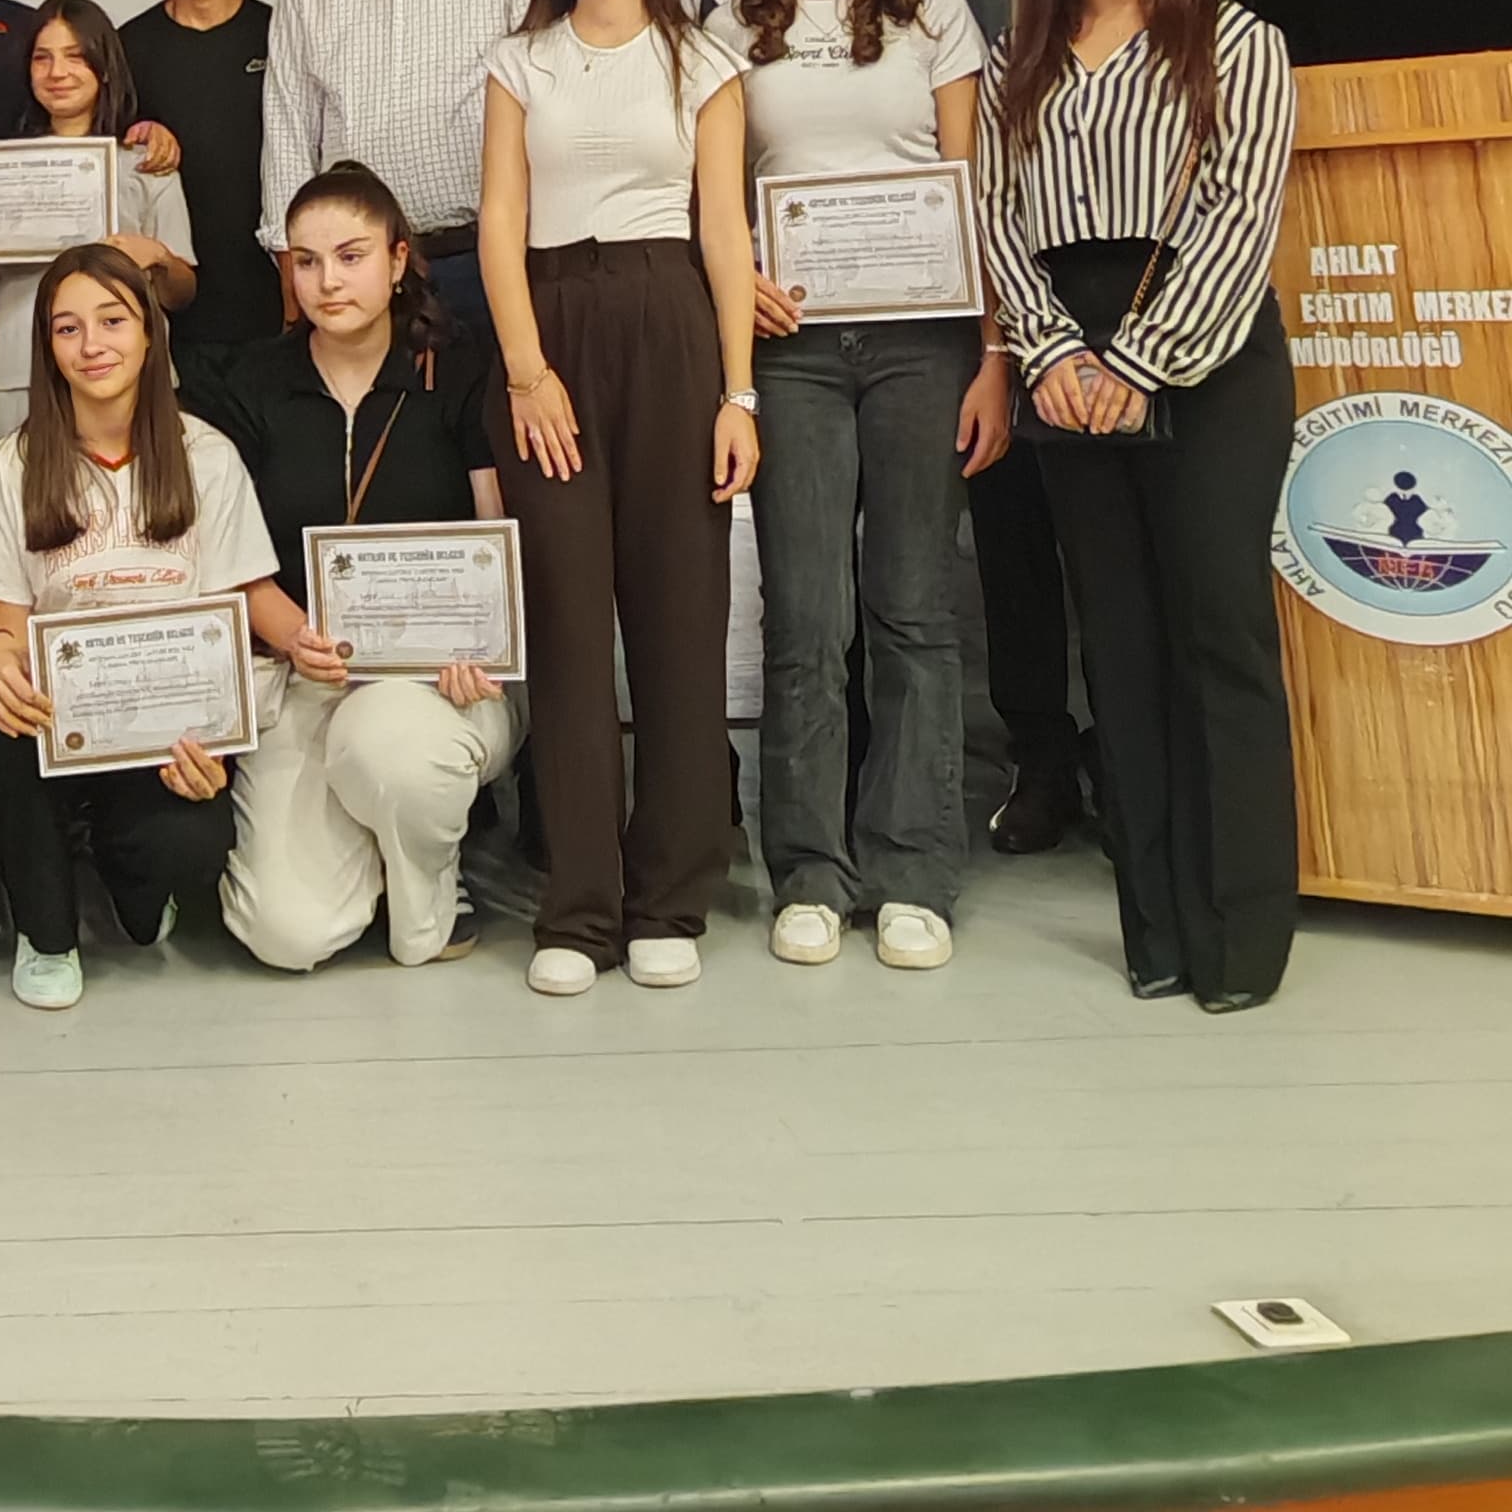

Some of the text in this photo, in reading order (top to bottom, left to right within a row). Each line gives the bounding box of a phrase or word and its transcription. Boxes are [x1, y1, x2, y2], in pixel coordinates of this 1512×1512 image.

[1310, 245, 1399, 276] AHLAT
[1300, 289, 1394, 323] EĞİTİM
[1289, 331, 1462, 368] MÜDÜRLÜĞÜ
